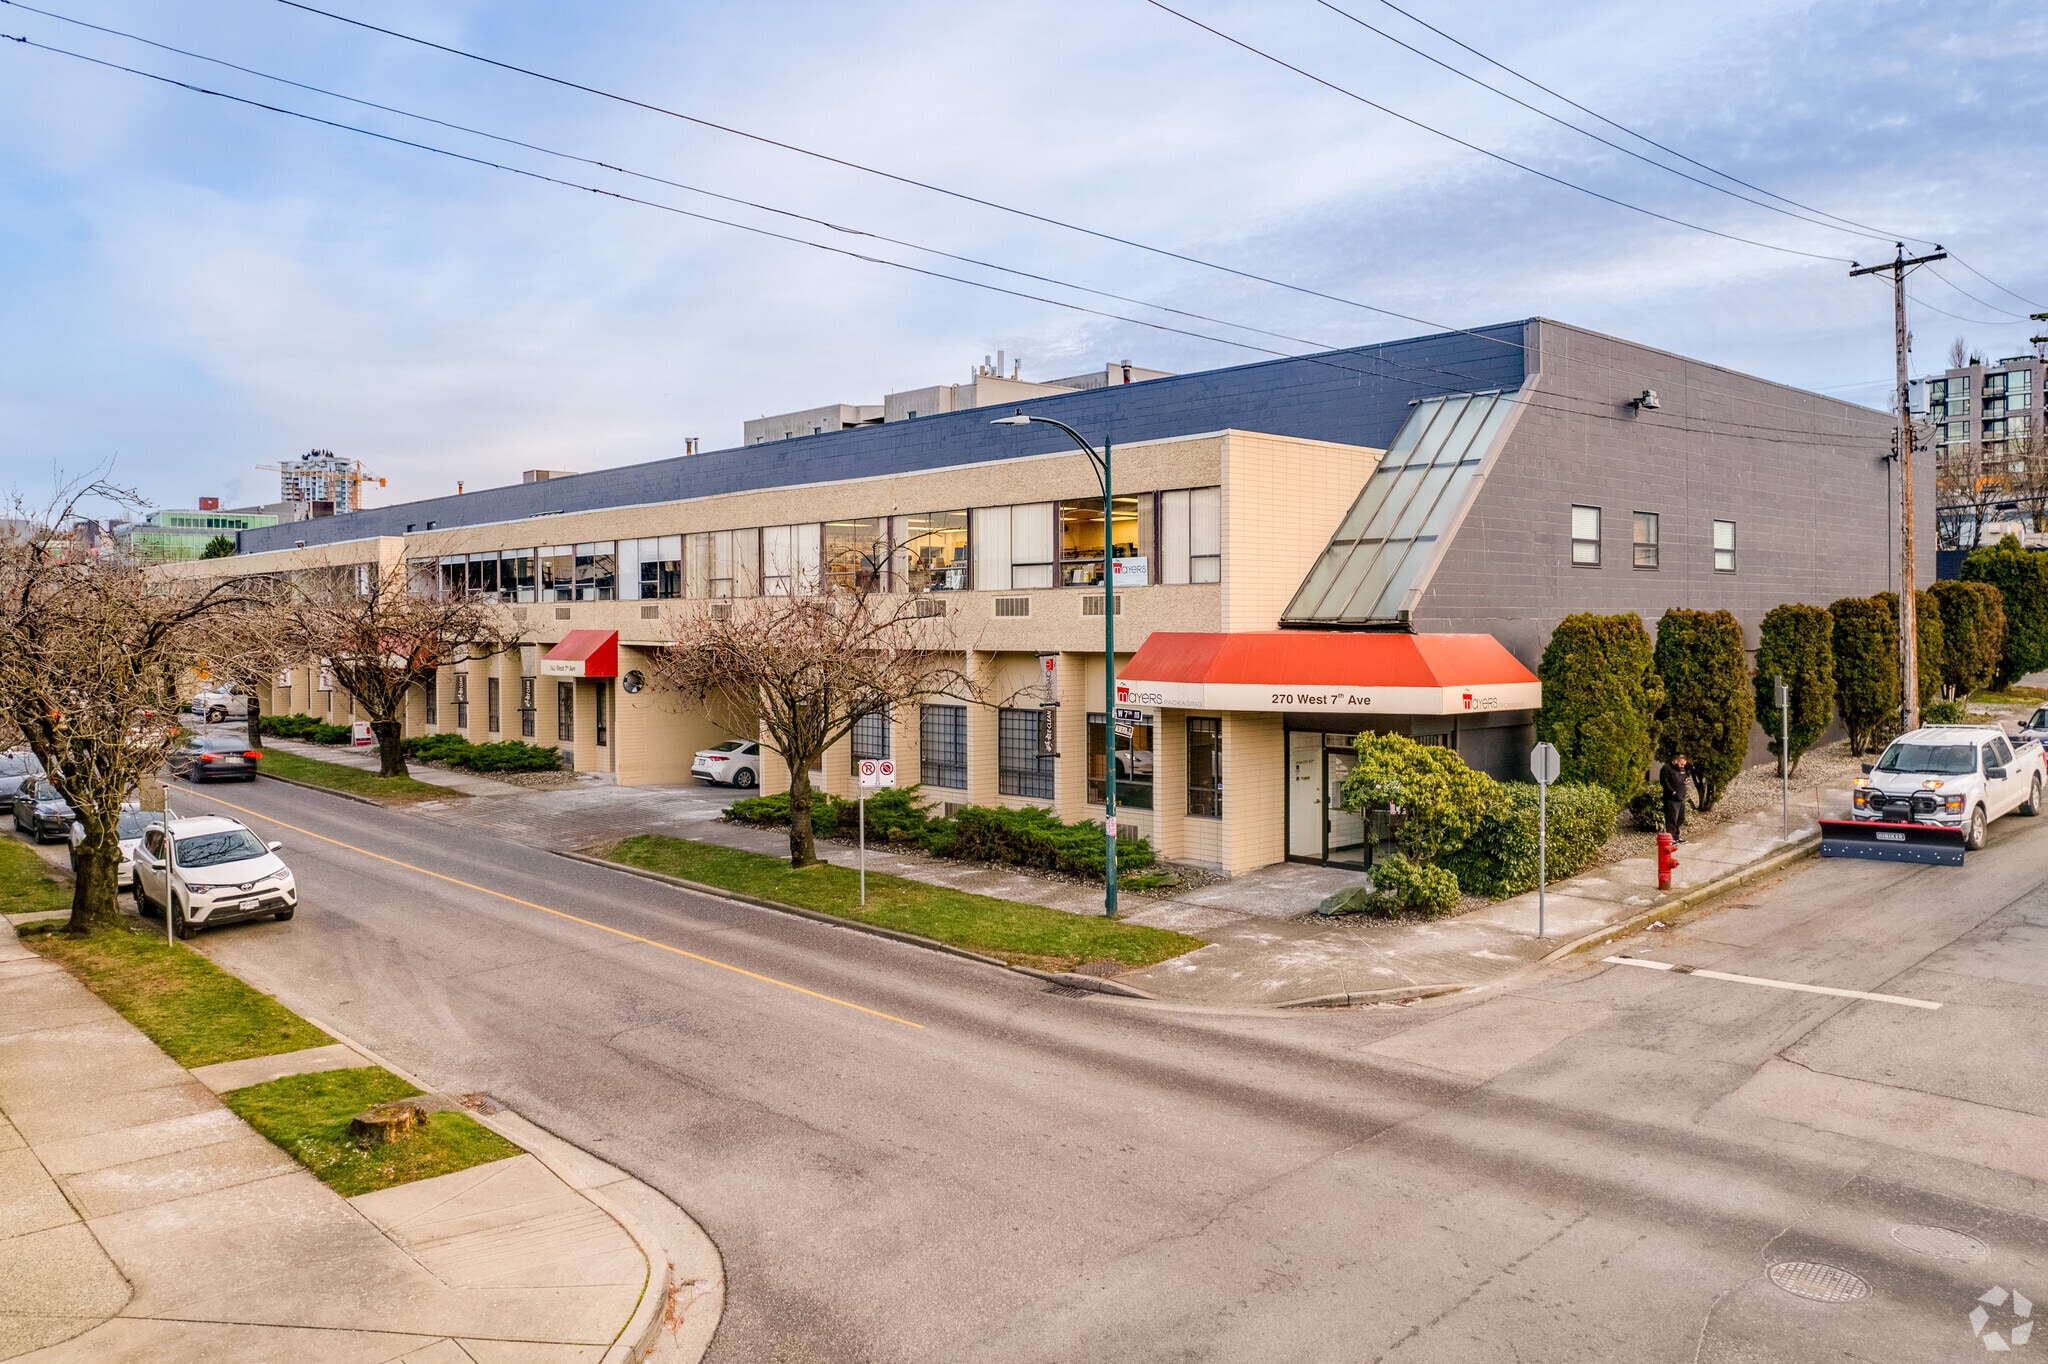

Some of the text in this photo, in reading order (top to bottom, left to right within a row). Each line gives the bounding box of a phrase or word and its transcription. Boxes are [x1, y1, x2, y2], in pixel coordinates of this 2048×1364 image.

[1163, 700, 1203, 708] PACKAGING
[1271, 693, 1371, 705] 270 West 7th Ave
